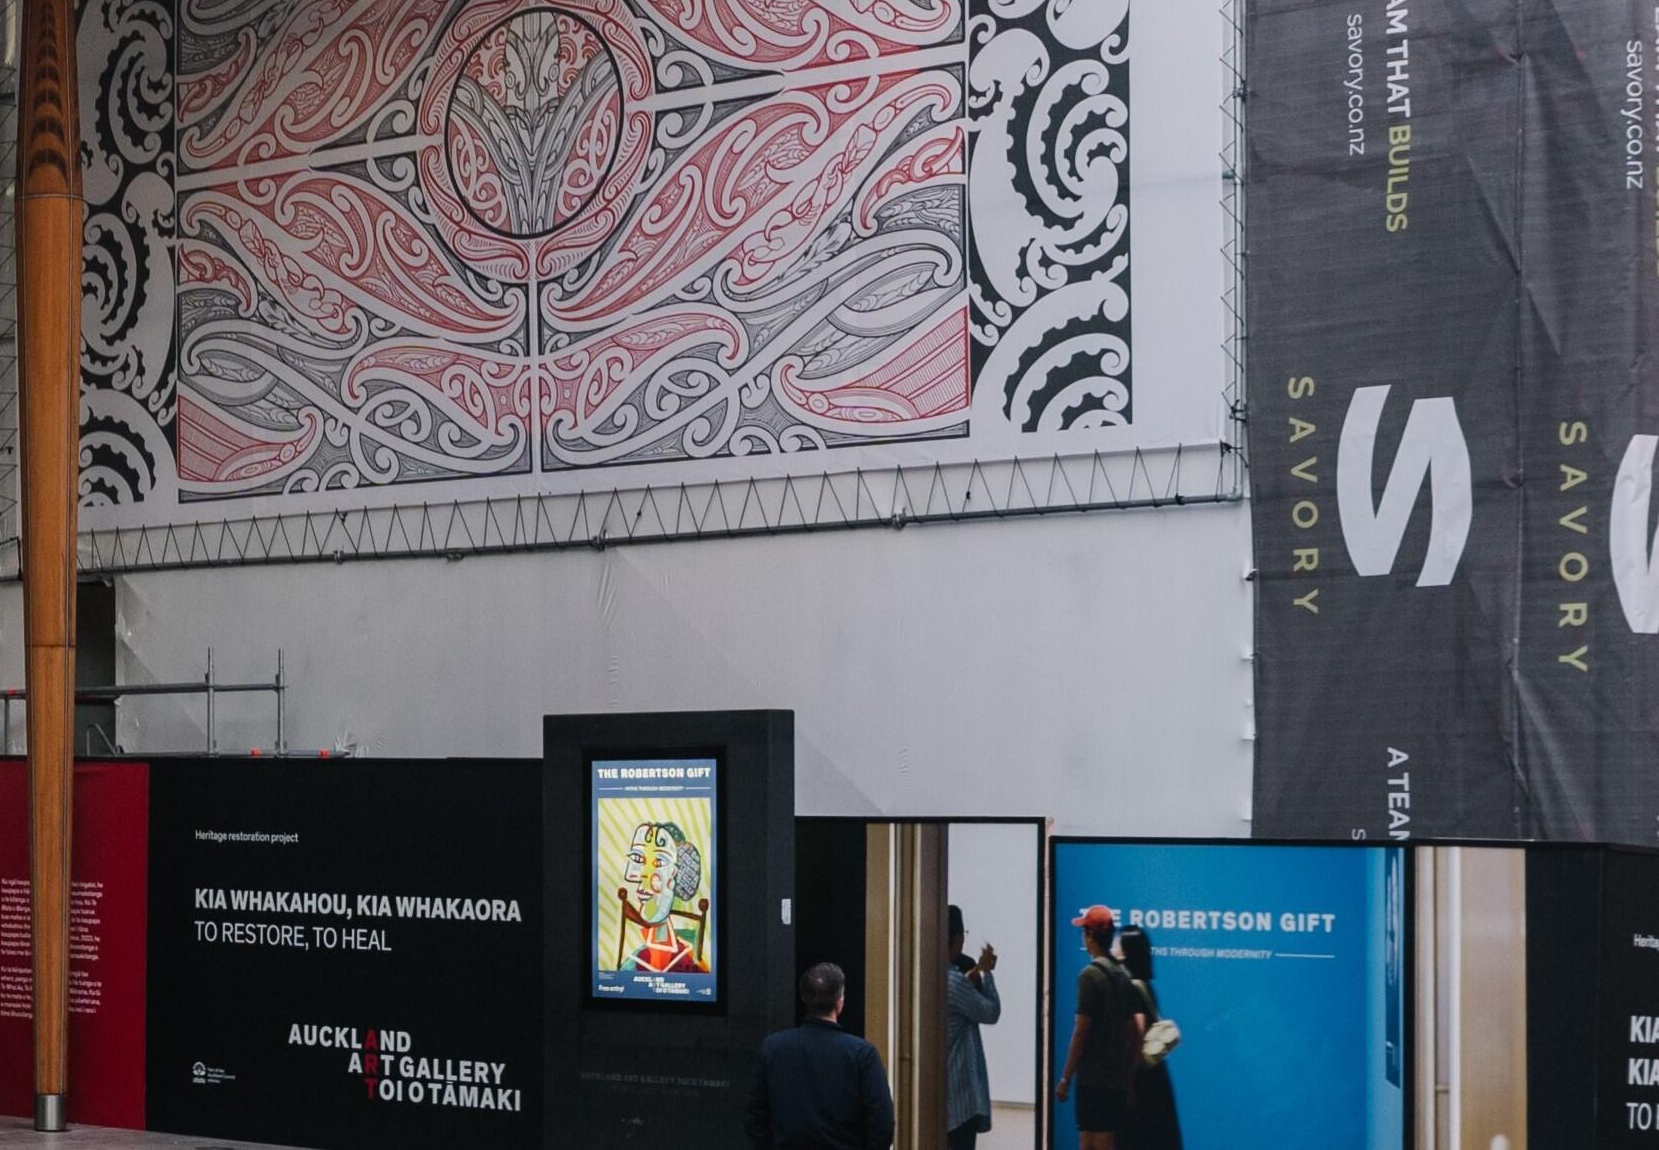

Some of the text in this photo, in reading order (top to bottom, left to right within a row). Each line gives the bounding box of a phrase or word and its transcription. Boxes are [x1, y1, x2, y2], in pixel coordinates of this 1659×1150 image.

[1343, 14, 1365, 156] savory.co.nz
[1386, 39, 1411, 118] THAT
[1620, 40, 1643, 190] savory.co.nz
[1386, 124, 1411, 232] BUILDS
[1287, 376, 1320, 614] SAVORY
[1558, 420, 1589, 673] SAVORY
[598, 767, 711, 779] THE ROBERTSON GIFT
[1387, 747, 1410, 768] A
[195, 830, 299, 845] Heritage restoration project
[195, 888, 522, 922] KIA WHAKAHOU, KIA WHAKAORA
[1129, 909, 1272, 932] ROBERTSON
[1280, 912, 1336, 933] GIFT
[194, 920, 392, 951] TO RESTORE, TO HEAL
[288, 1023, 412, 1053] AUCKLAND
[348, 1052, 506, 1085] ART GALLERY
[364, 1077, 522, 1112] TOI O TĀMAKI
[1626, 1101, 1653, 1131] TO
